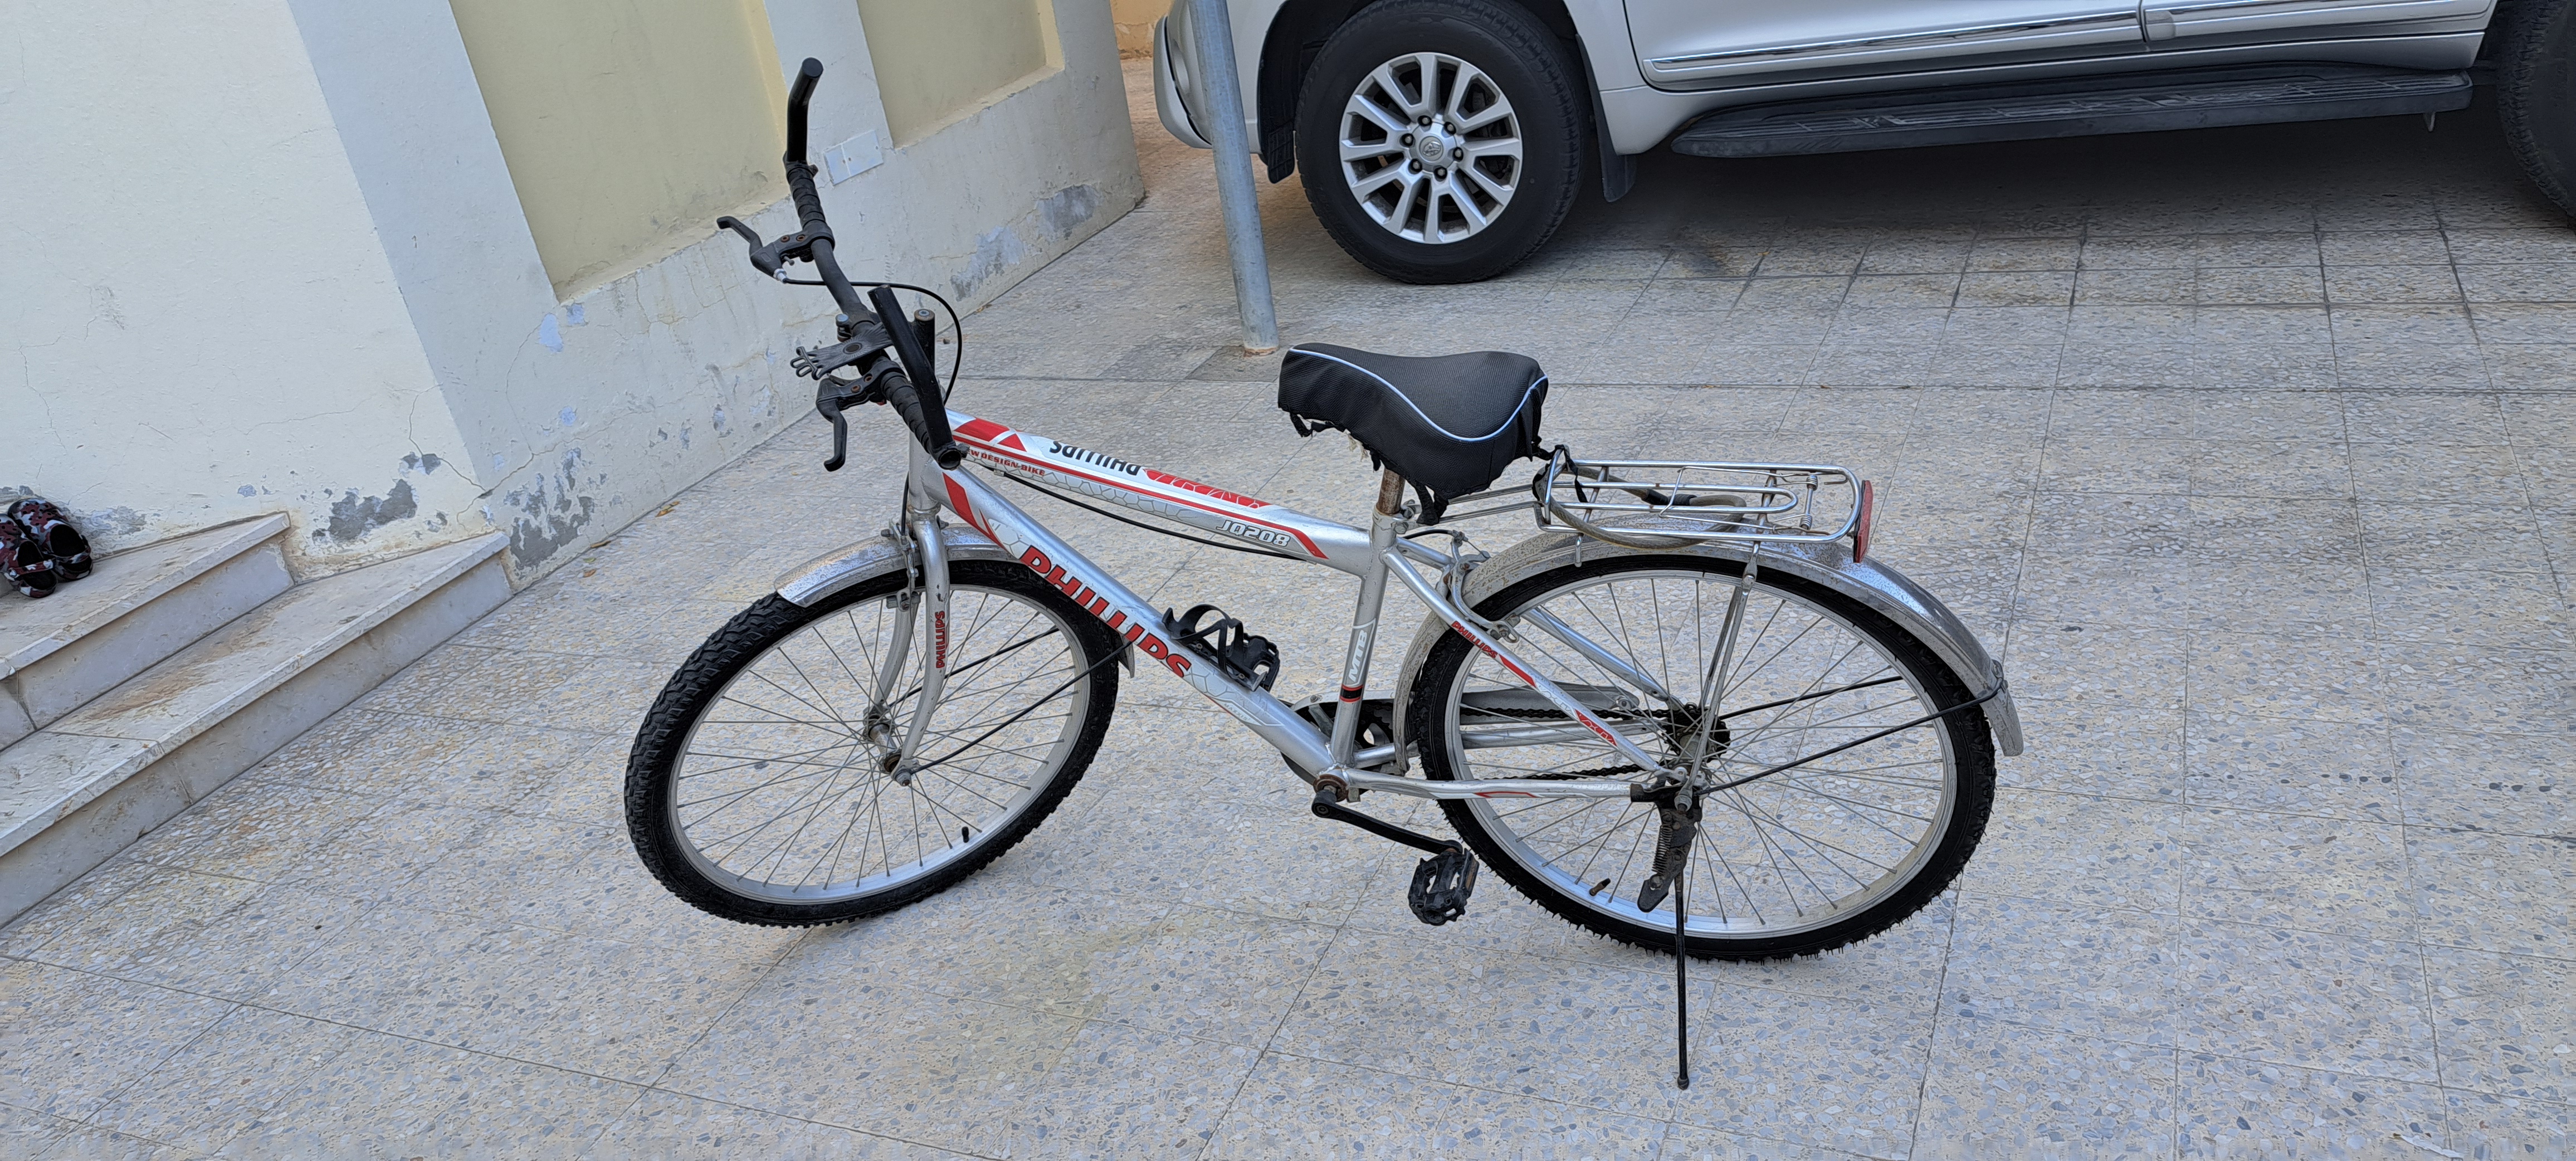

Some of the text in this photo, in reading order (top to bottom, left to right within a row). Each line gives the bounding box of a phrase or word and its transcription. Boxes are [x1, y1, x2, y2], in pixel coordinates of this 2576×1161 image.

[981, 452, 1018, 468] DESIGN
[1021, 464, 1045, 476] BIKE
[1216, 520, 1291, 547] JQ208
[1019, 544, 1192, 678] PHILLIPS
[935, 611, 945, 668] PHILLIPS
[1349, 630, 1367, 682] MTB
[1451, 621, 1498, 658] PHILLIPS
[1223, 703, 1247, 720] MAXXIS
